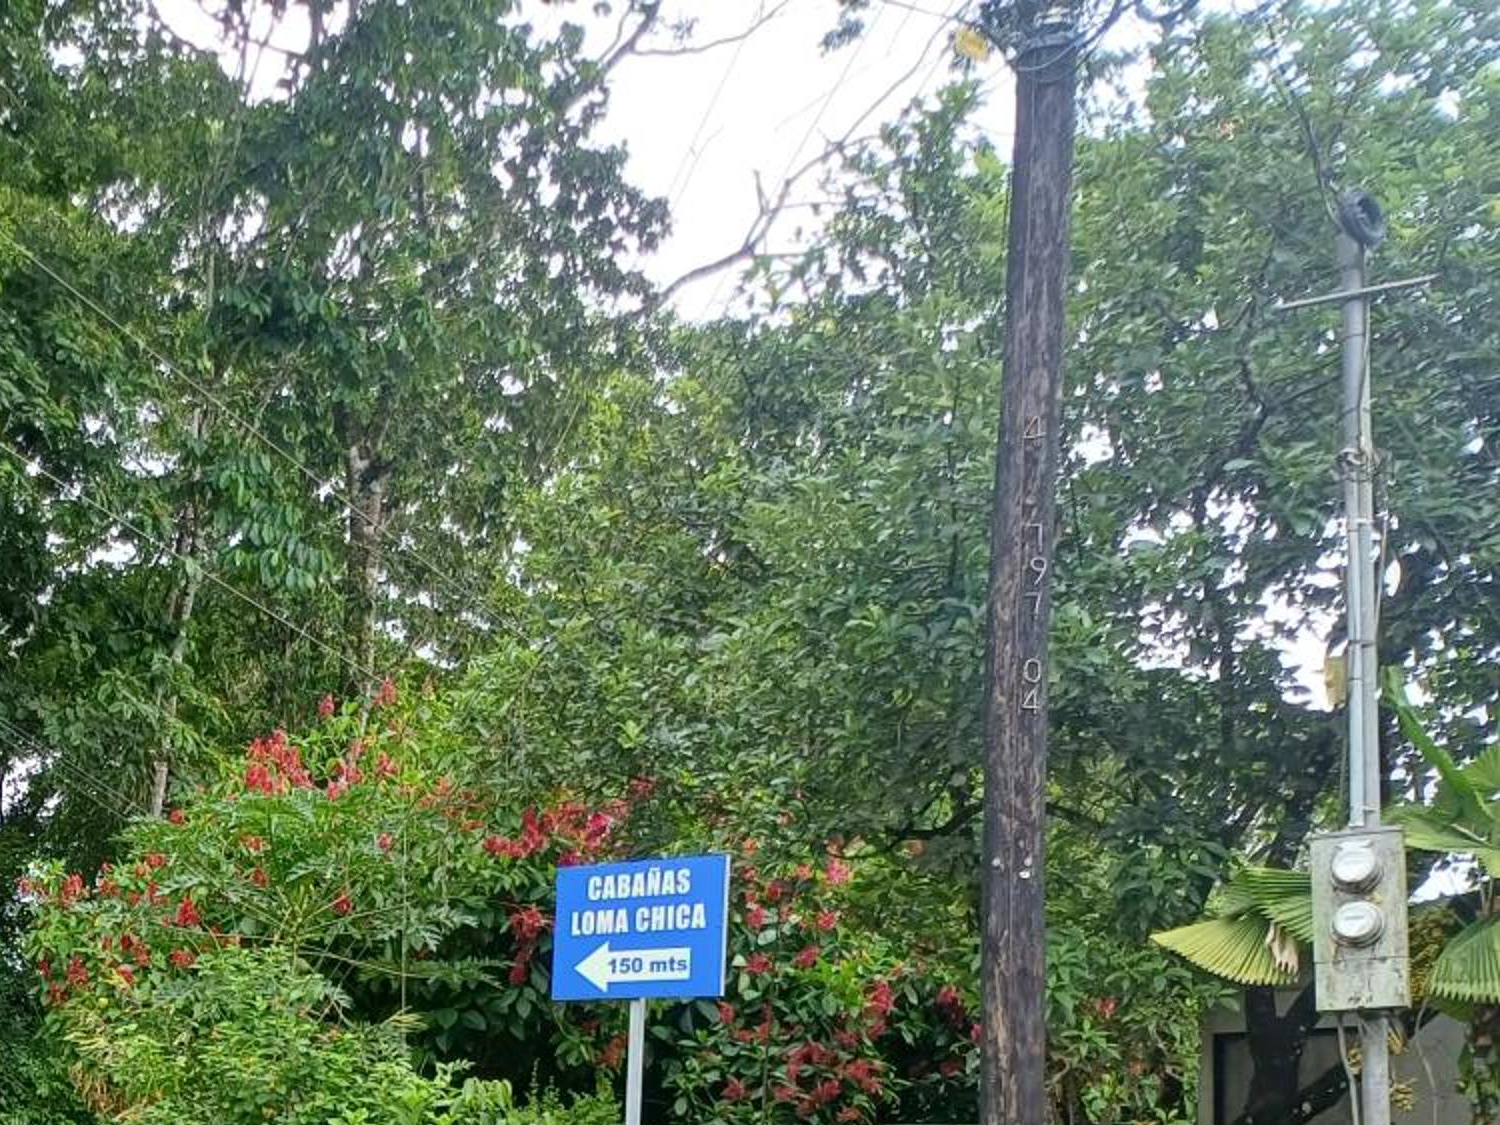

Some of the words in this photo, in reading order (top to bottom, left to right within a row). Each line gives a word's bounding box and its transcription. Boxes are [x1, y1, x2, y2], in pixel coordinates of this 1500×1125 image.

[587, 867, 691, 901] CABAÑAS
[571, 908, 629, 936] LOMA
[635, 903, 706, 932] CHICA
[608, 957, 643, 974] 150
[649, 955, 688, 972] mts
